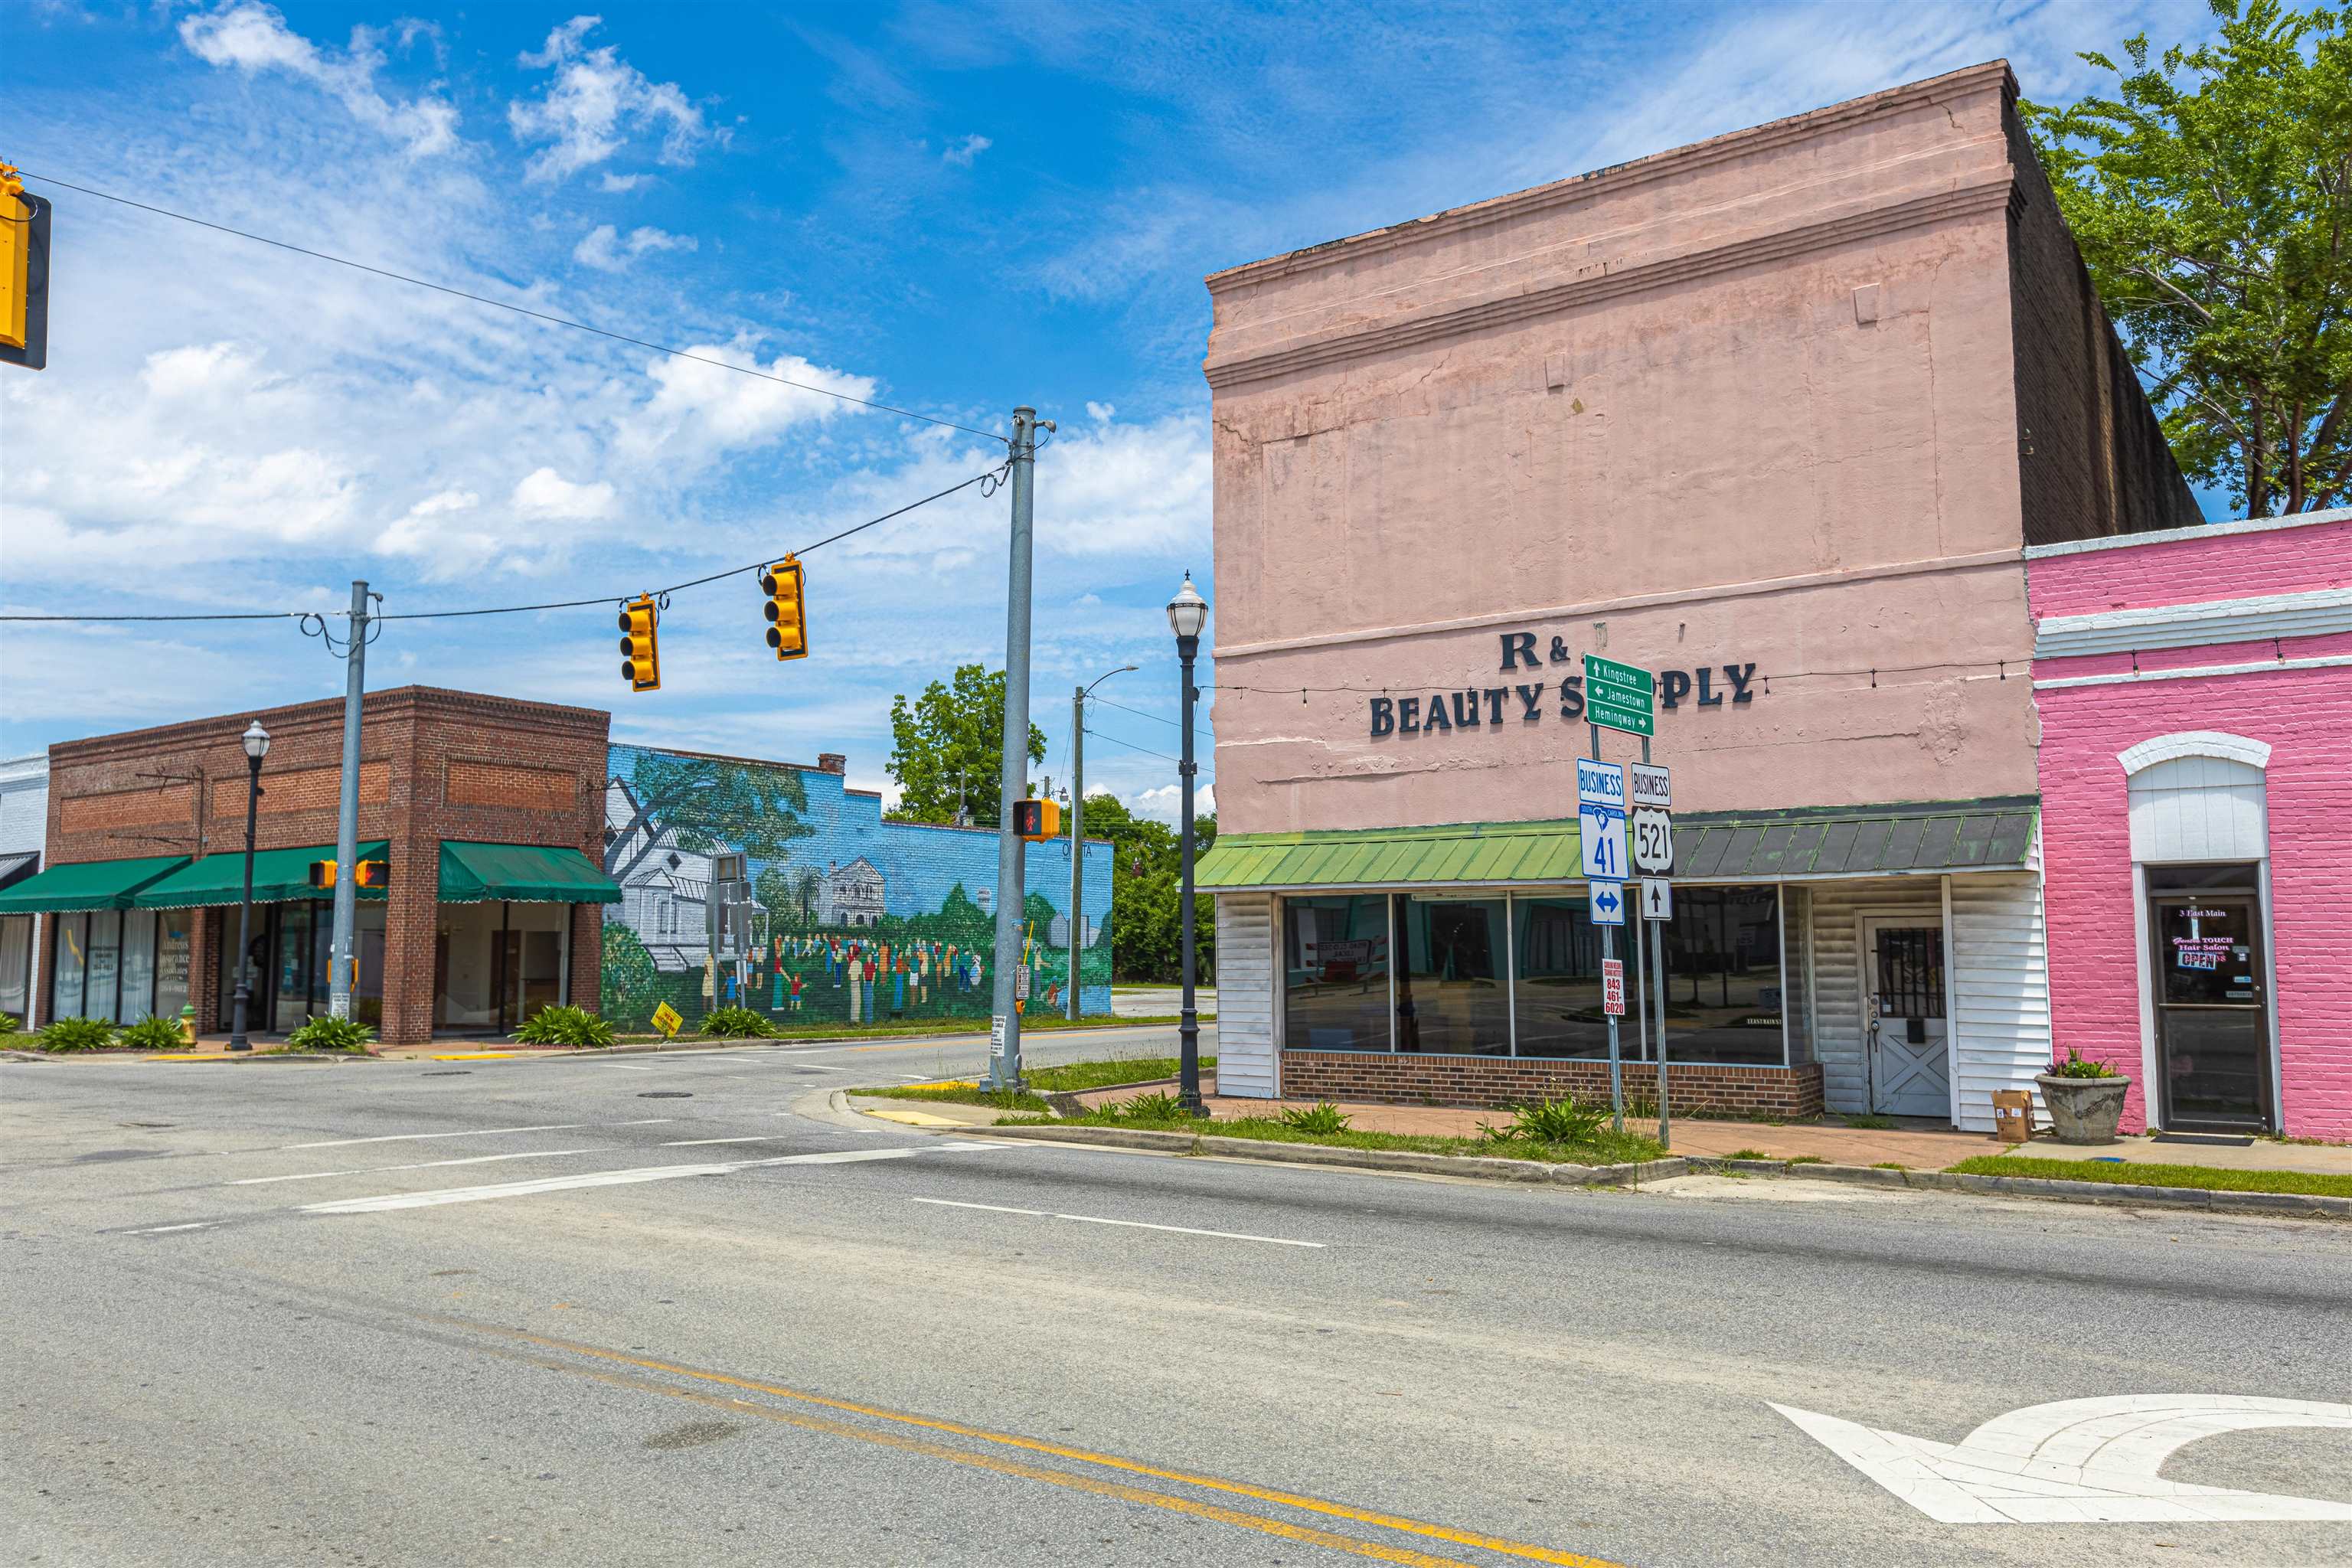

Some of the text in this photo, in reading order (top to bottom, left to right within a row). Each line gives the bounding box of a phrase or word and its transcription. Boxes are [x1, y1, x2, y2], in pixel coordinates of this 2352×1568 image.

[1500, 632, 1570, 668] R &
[1603, 664, 1637, 686] Kingstree
[1370, 662, 1756, 737] BEAUTY SPLY
[1607, 688, 1645, 709] Jamestown
[1595, 706, 1636, 729] Hemingway
[1580, 769, 1622, 797] BUSINESS
[1634, 778, 1669, 798] BUSINESS
[1607, 808, 1624, 818] CAROLINA
[1639, 822, 1668, 860] 521
[1594, 837, 1615, 874] 41
[2182, 953, 2214, 969] OPEN
[1606, 978, 1621, 990] 843
[1605, 1001, 1624, 1014] 6020
